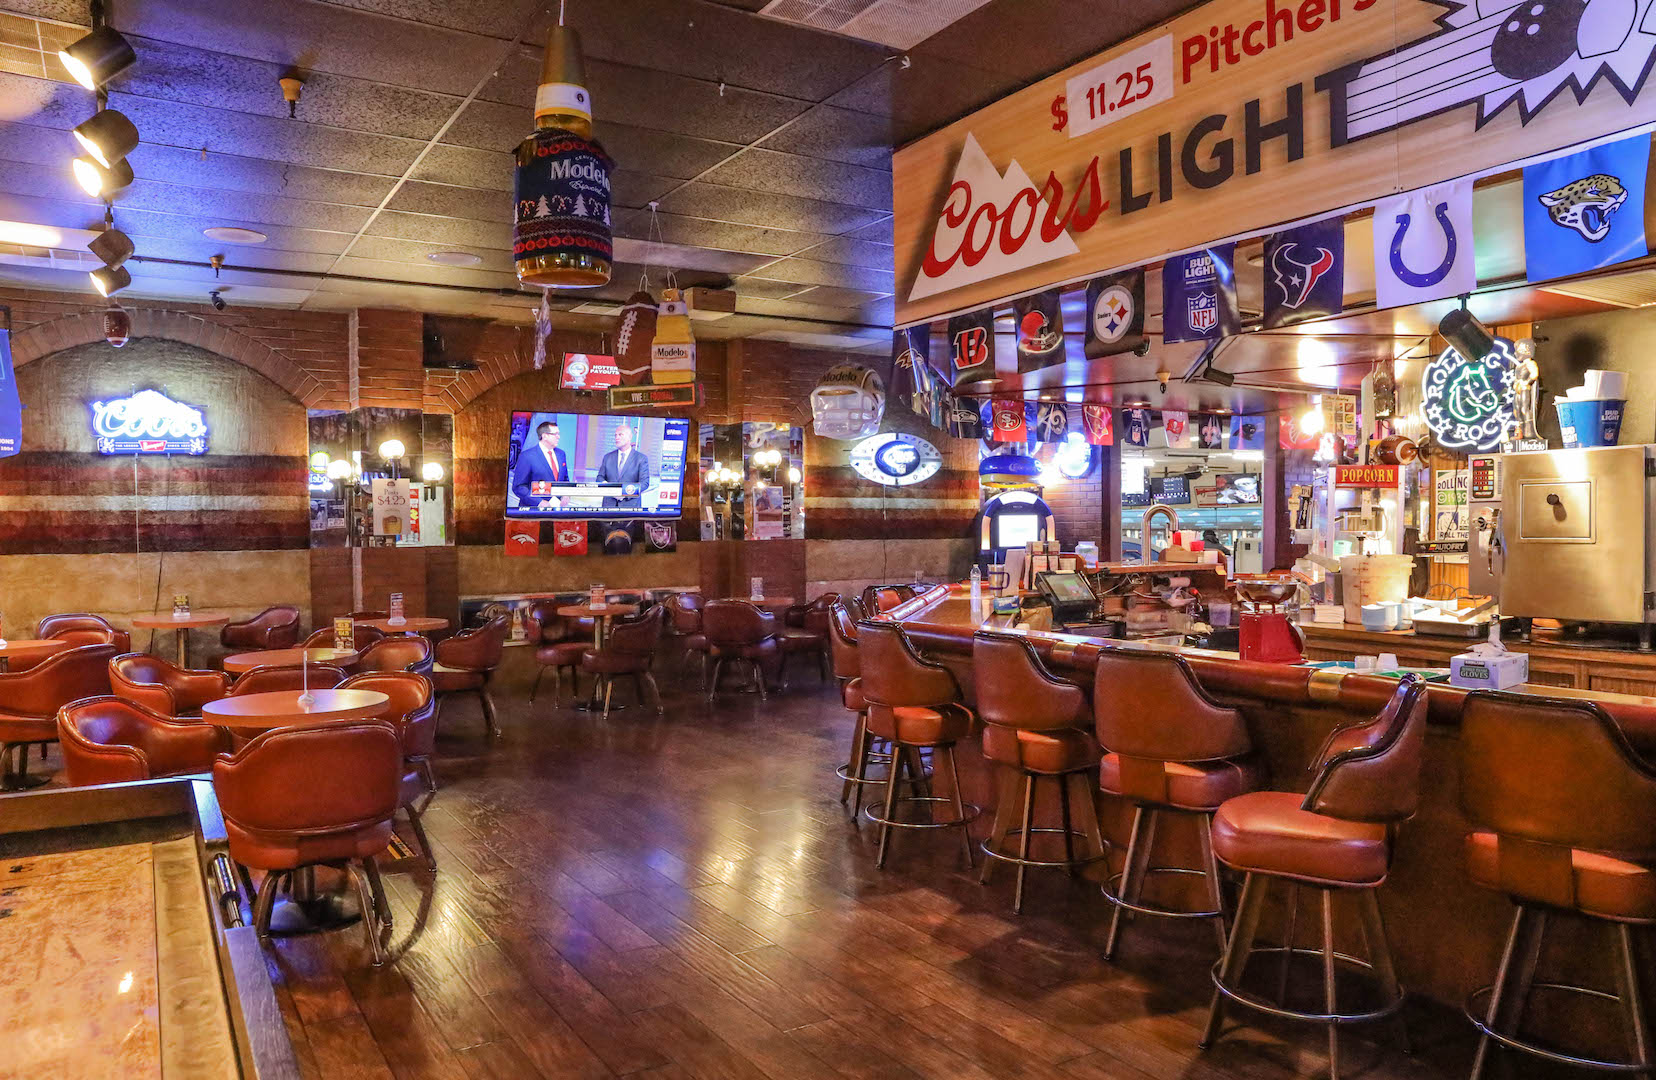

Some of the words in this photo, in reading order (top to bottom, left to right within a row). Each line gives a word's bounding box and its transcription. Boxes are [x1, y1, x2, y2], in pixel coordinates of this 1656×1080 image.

[1051, 95, 1068, 132] $
[1086, 62, 1154, 120] 11.25
[550, 158, 610, 192] Modelo
[922, 156, 1110, 278] Coors
[1119, 59, 1365, 215] LIGHT
[1190, 256, 1212, 269] BUD
[1185, 264, 1216, 279] LIGHT
[1193, 309, 1215, 327] NFL
[657, 347, 684, 357] Modelo
[823, 371, 857, 381] Modelo
[1428, 352, 1501, 399] ROLLG
[1341, 469, 1394, 482] POPCORN
[377, 496, 406, 506] $4.25
[1457, 531, 1468, 539] THE
[1460, 670, 1488, 679] GLOVES
